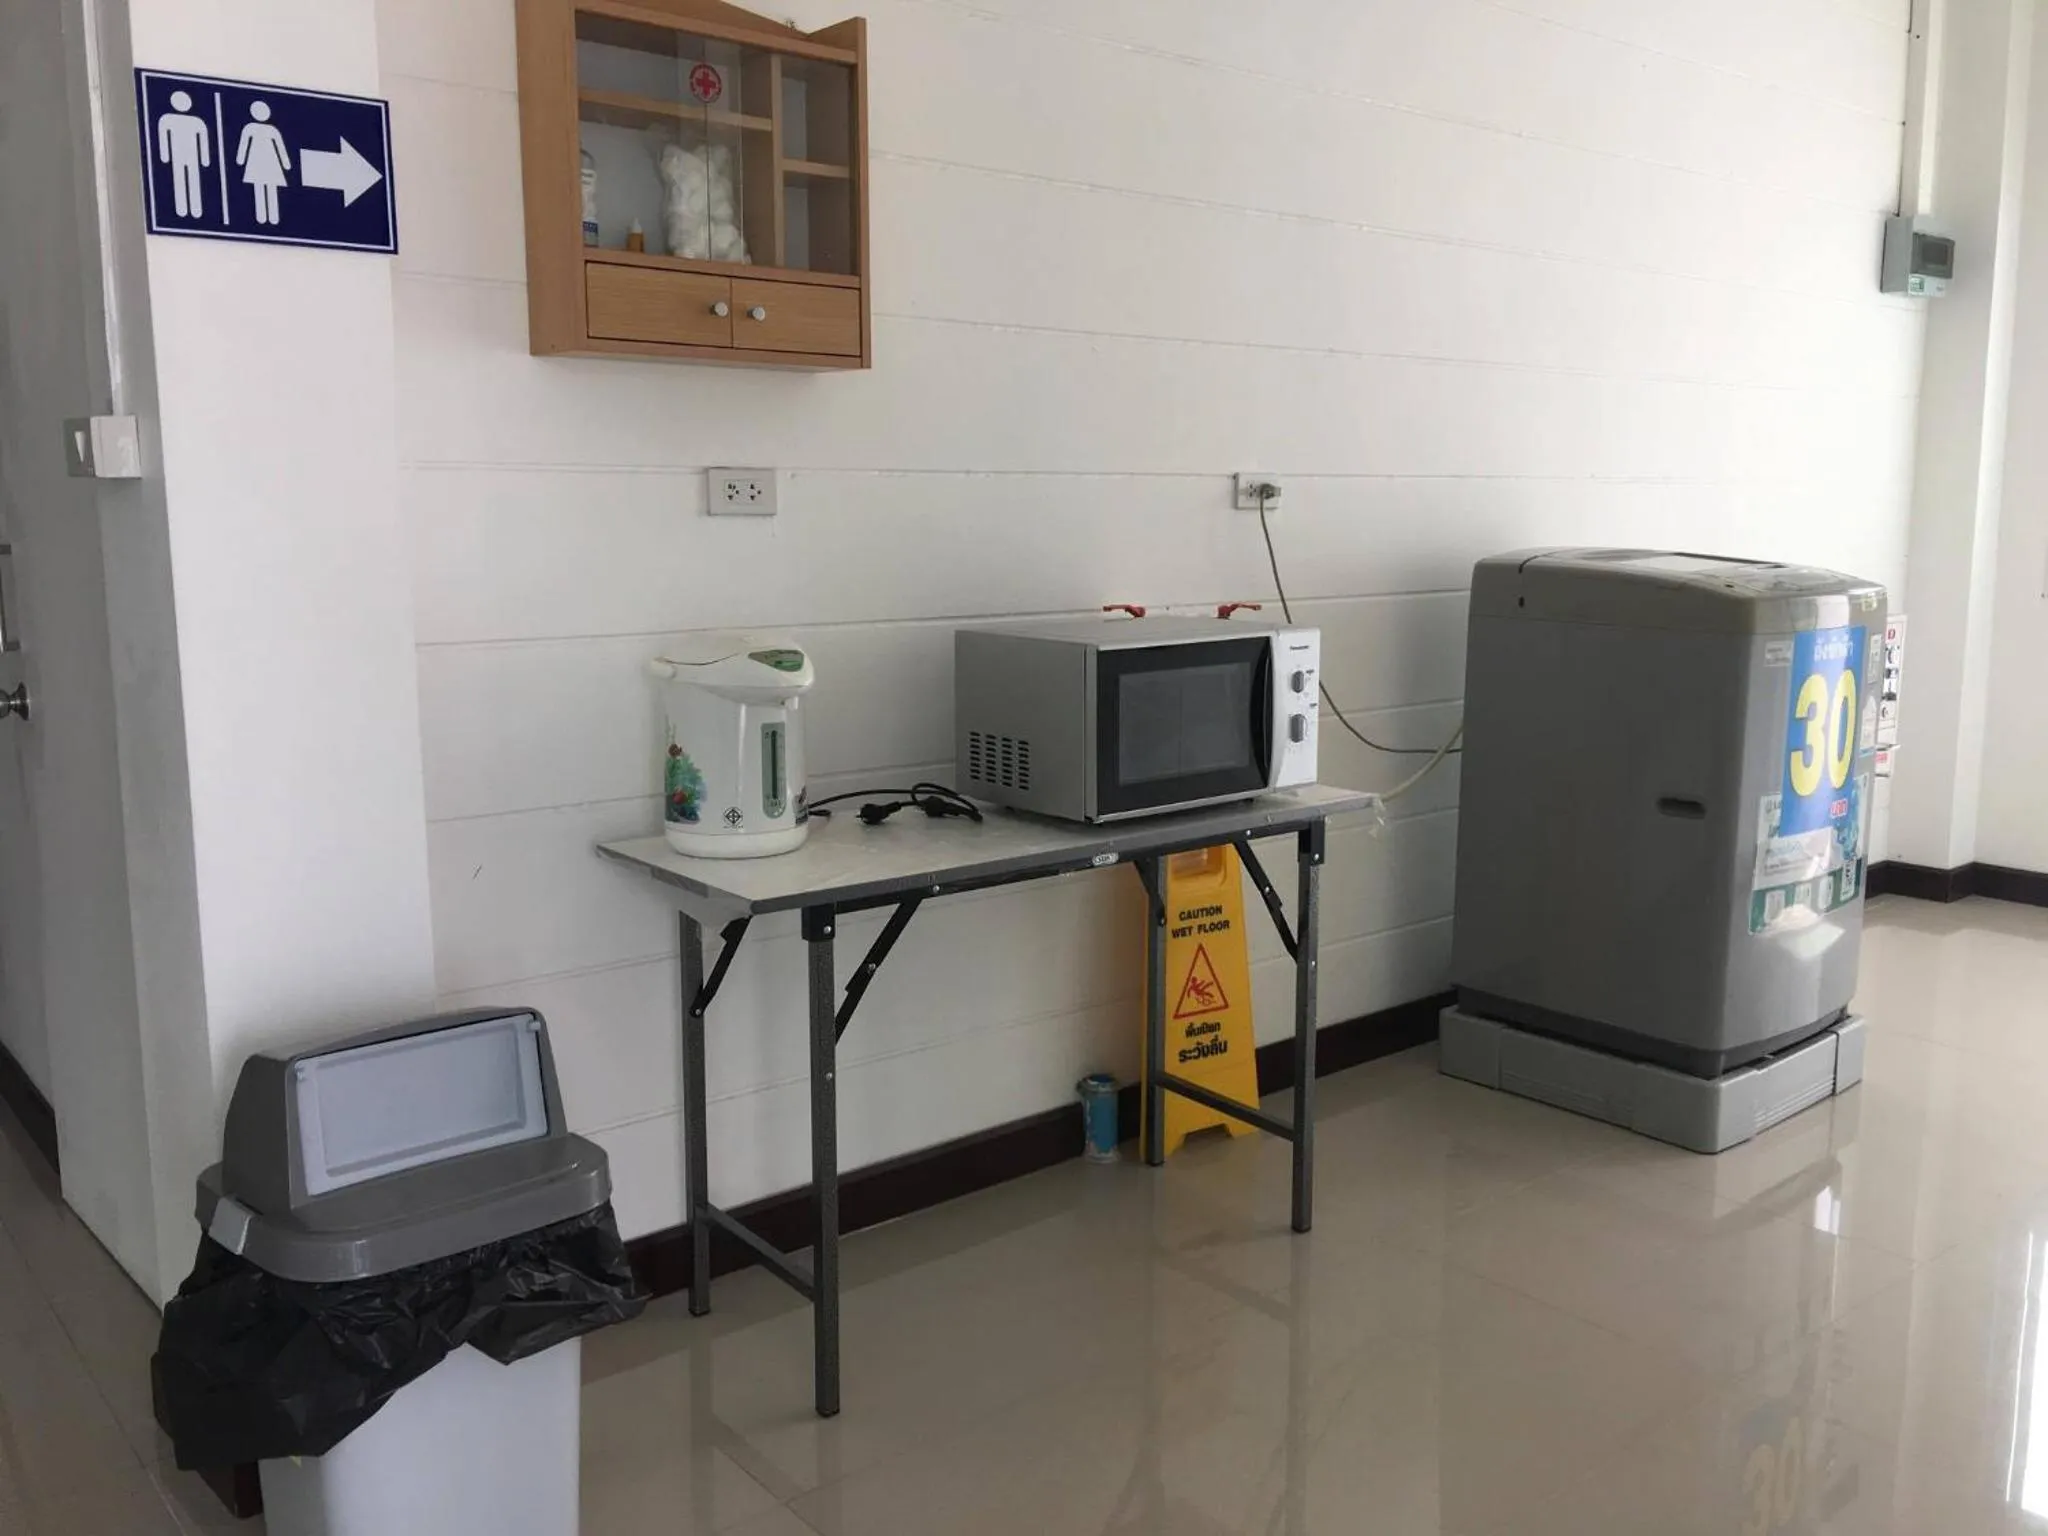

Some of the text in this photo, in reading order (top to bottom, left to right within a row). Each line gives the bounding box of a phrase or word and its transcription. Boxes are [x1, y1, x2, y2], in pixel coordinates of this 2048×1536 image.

[1790, 669, 1856, 796] 30
[1179, 904, 1223, 921] CAUTION
[1171, 920, 1230, 939] WET FLOOR
[1178, 1035, 1228, 1062] ระวังลื่น
